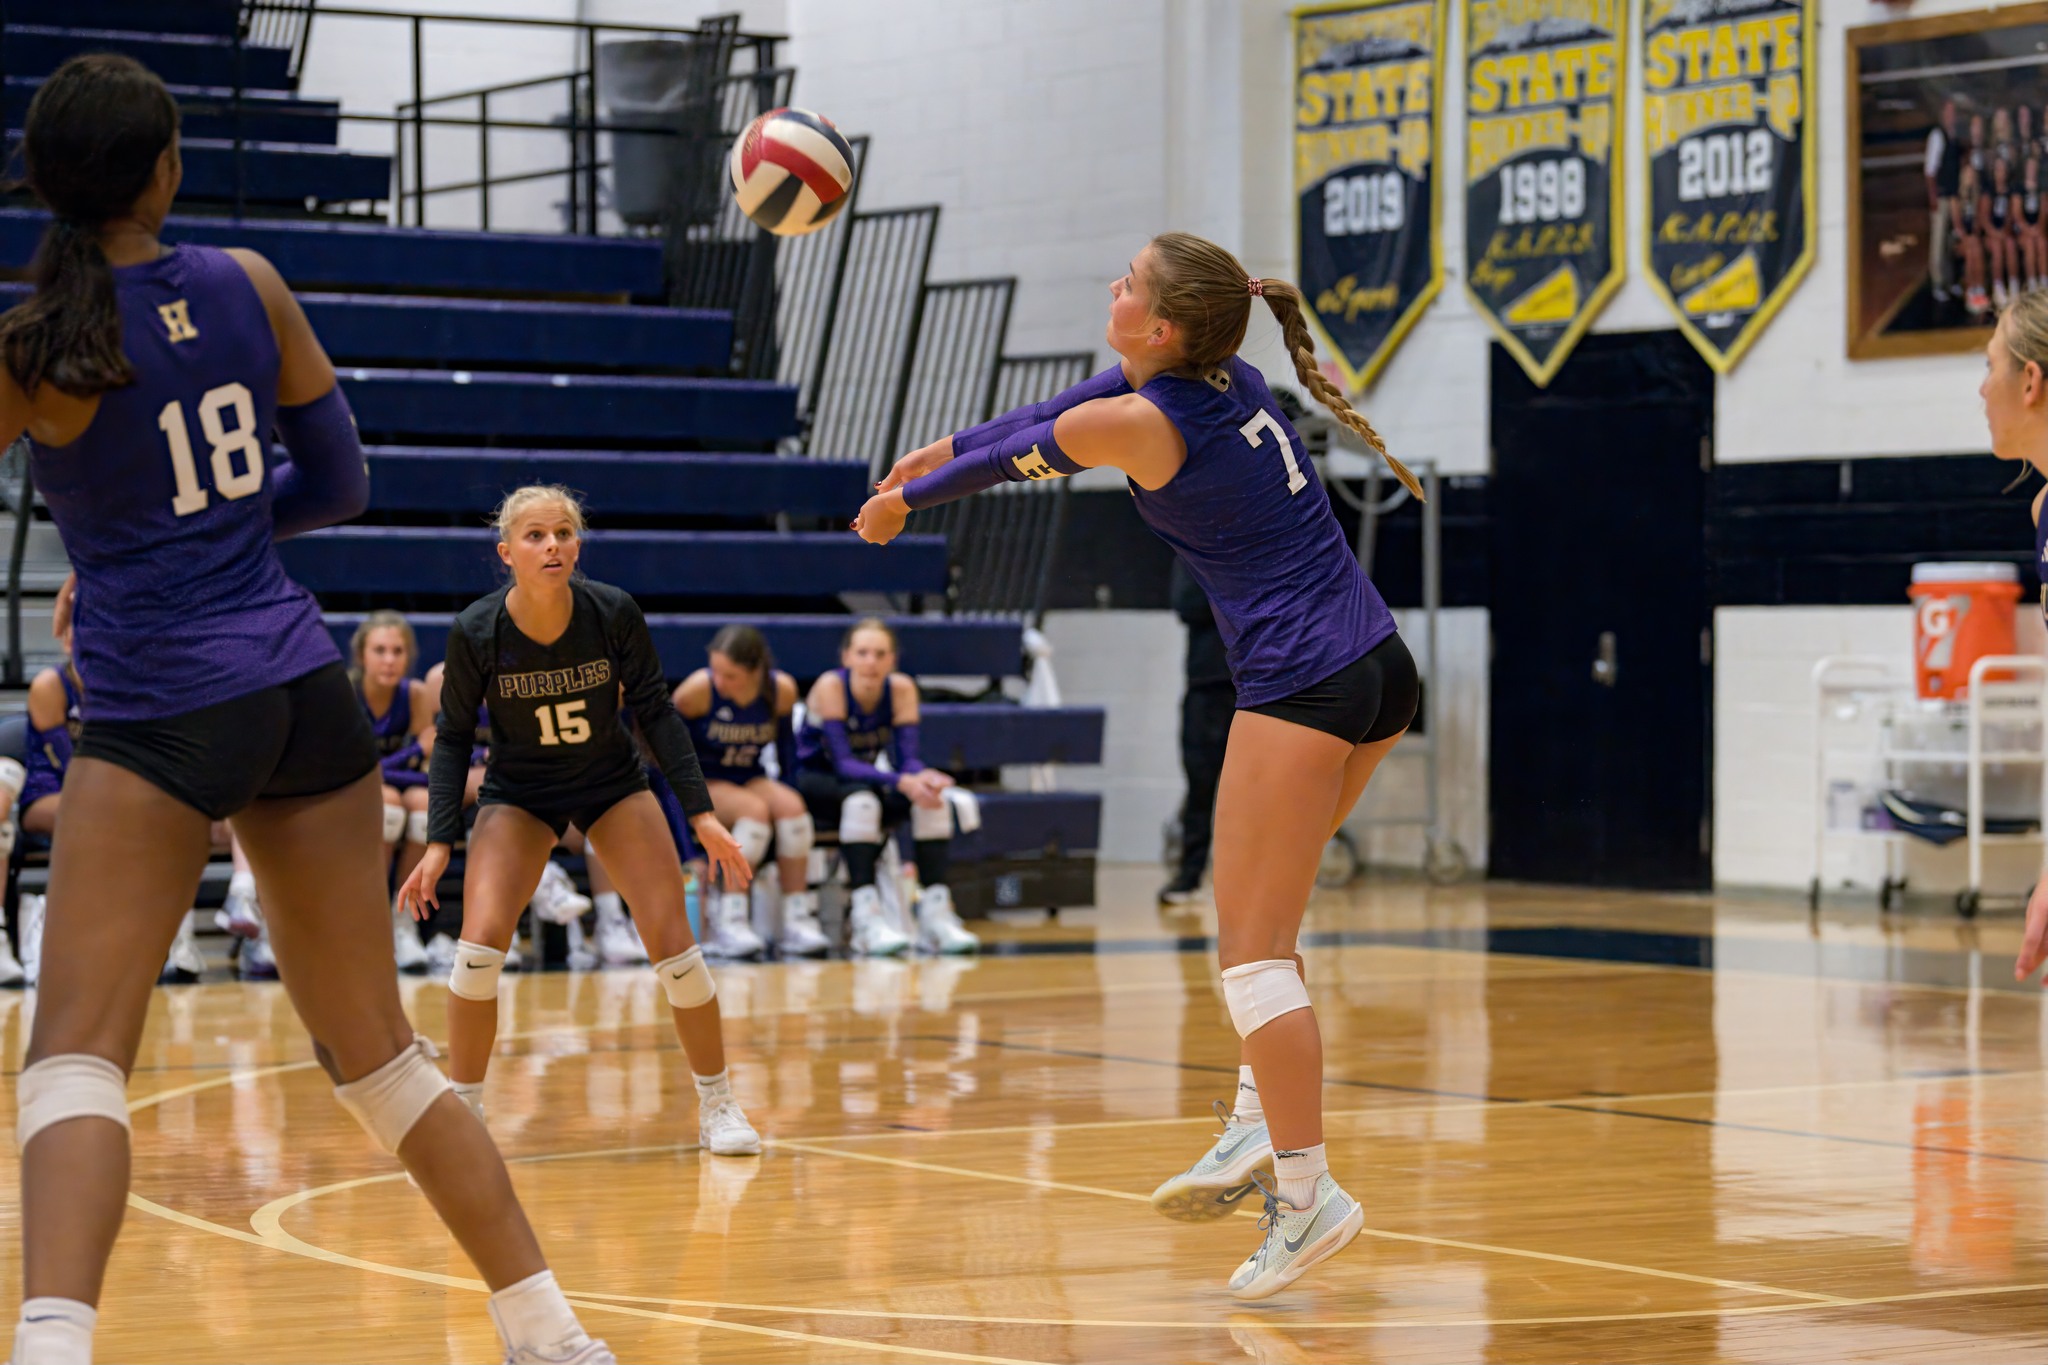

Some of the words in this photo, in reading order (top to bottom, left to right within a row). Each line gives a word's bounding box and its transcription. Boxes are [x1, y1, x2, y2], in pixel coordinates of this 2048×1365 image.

[1470, 41, 1614, 113] STATE
[1644, 13, 1799, 89] STATE
[1298, 58, 1430, 127] STATE
[1643, 72, 1800, 158] RUNNER-UP
[1499, 157, 1586, 225] 1998
[1678, 130, 1773, 201] 2012
[1323, 171, 1405, 236] 2019
[157, 299, 199, 344] H
[158, 381, 264, 517] 18
[1239, 408, 1308, 496] 7
[1921, 599, 1952, 637] G
[498, 658, 611, 699] PURPLES
[534, 699, 592, 746] 15
